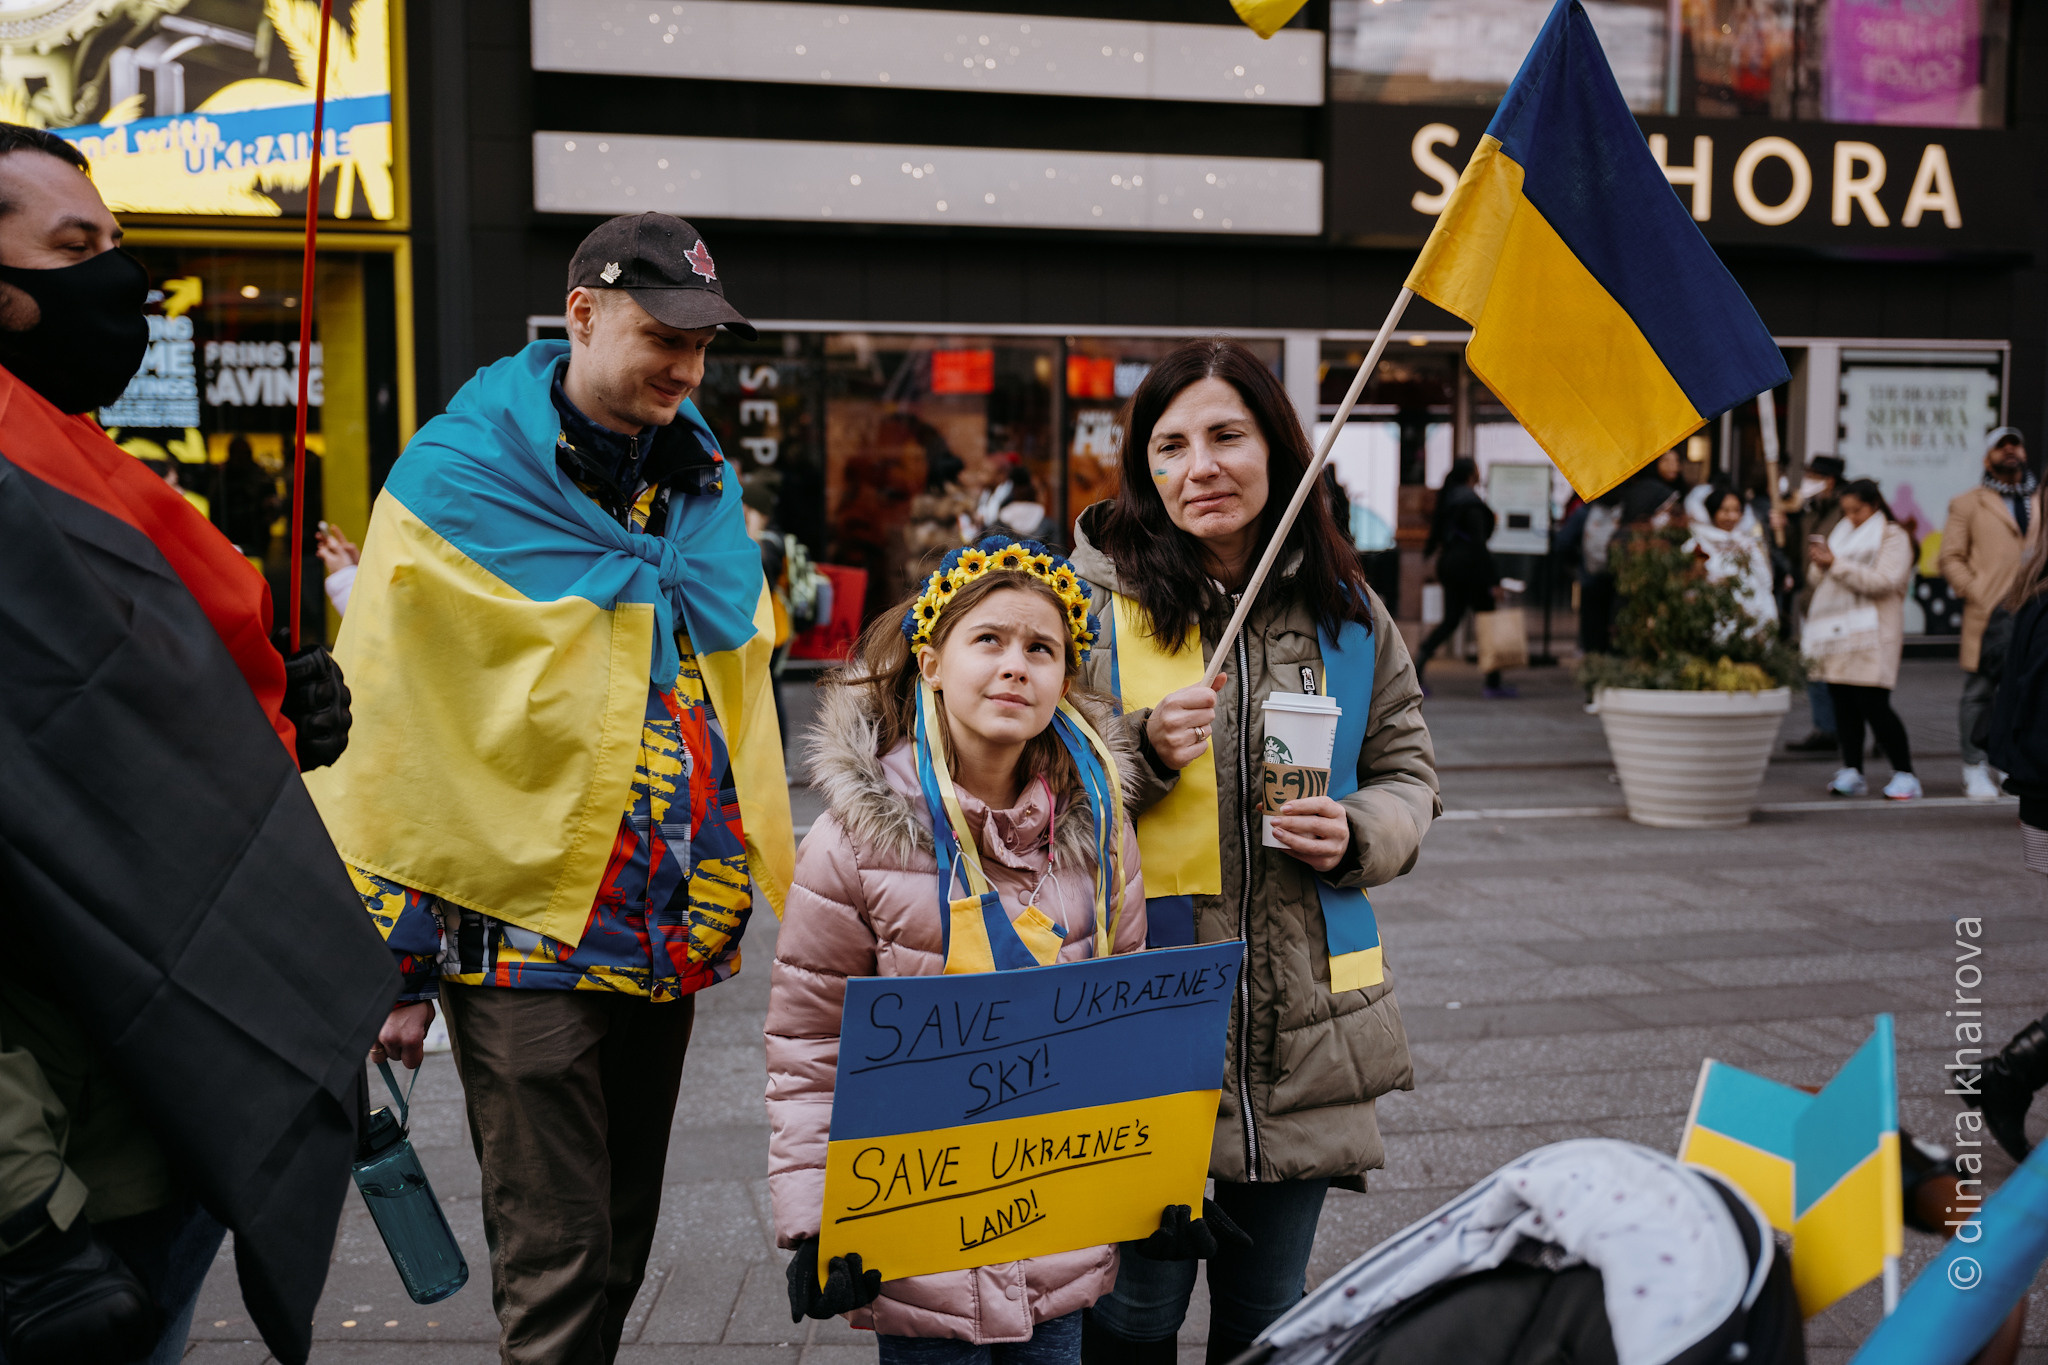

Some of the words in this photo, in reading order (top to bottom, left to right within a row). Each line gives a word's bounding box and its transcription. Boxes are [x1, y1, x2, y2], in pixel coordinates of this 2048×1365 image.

[134, 116, 220, 152] with
[1411, 122, 1963, 229] SHORA
[739, 364, 779, 465] SEP
[865, 993, 1011, 1061] SAVE
[1054, 963, 1232, 1024] UKRAINE'S
[967, 1044, 1051, 1114] SKY!
[847, 1146, 960, 1211] SAVE
[960, 1189, 1038, 1247] LAND!
